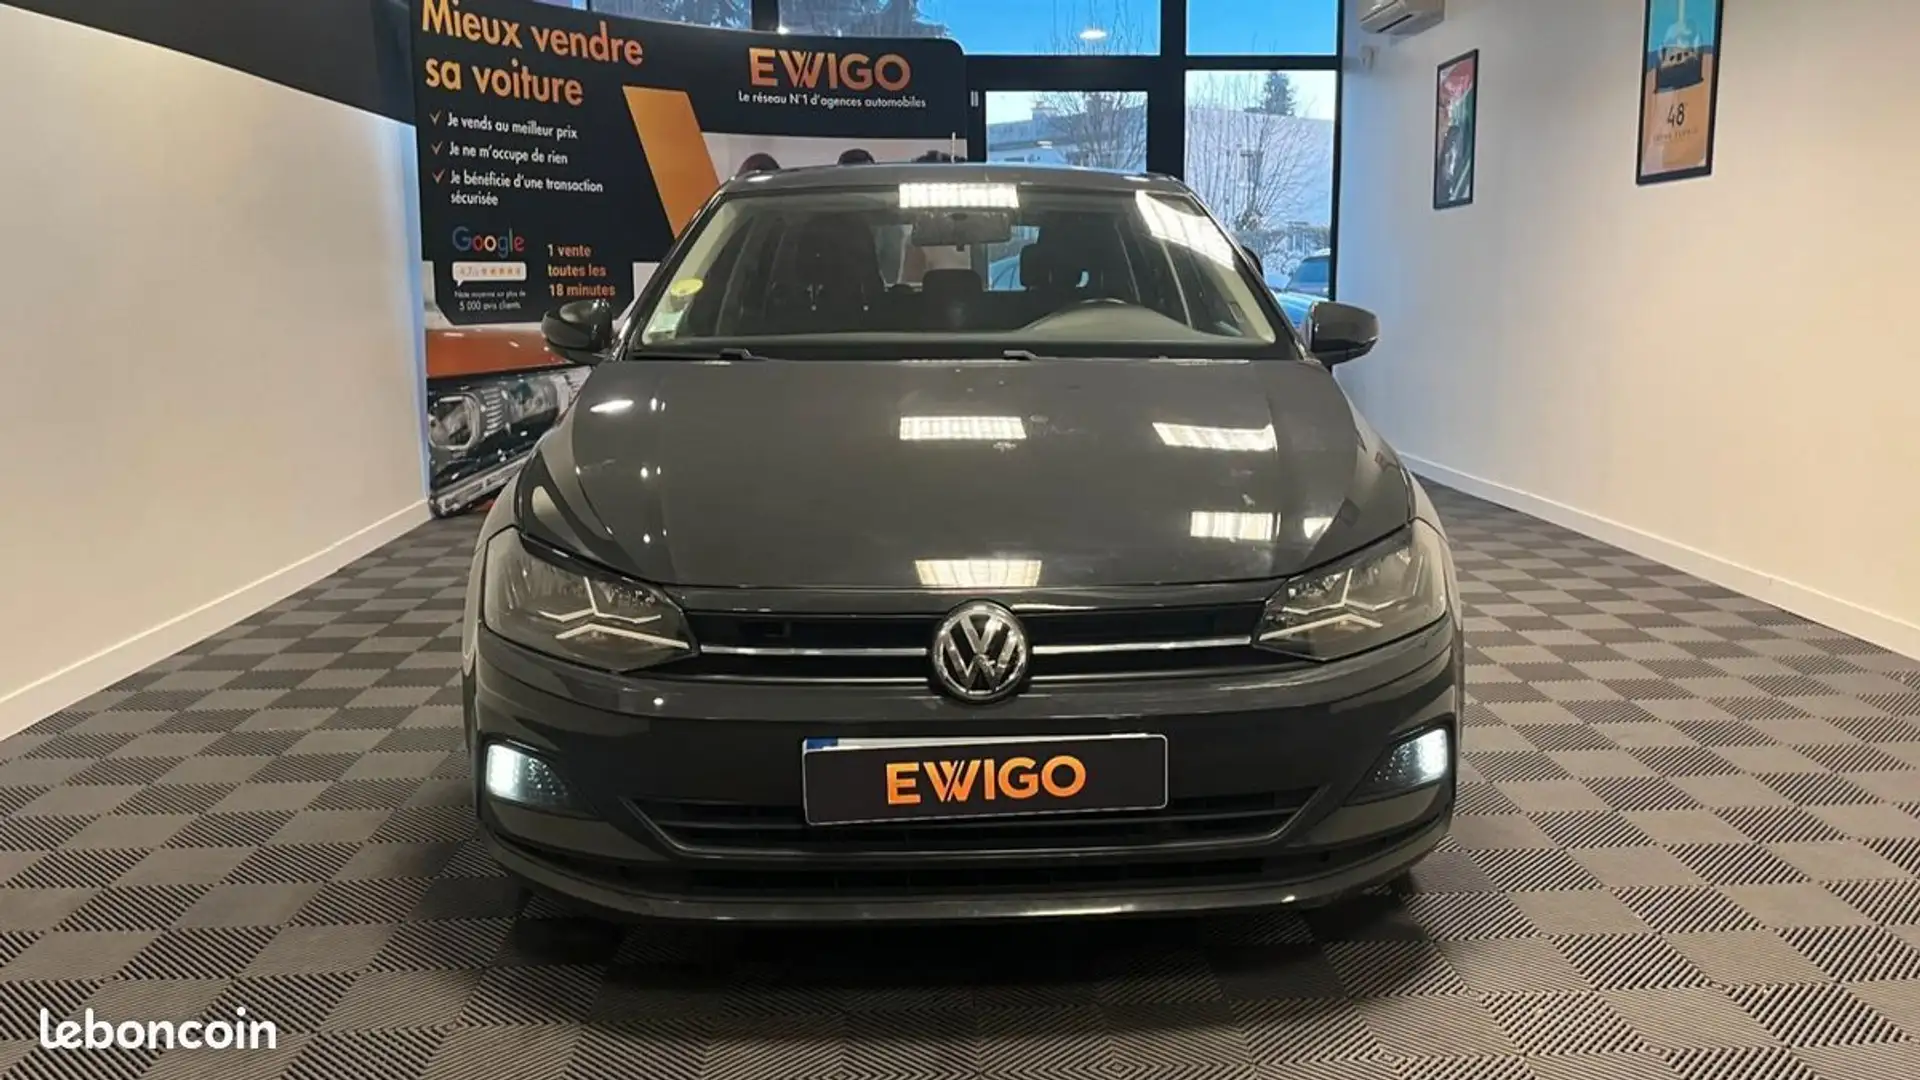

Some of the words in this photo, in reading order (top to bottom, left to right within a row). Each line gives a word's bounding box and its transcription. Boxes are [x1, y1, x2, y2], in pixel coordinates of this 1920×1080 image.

[422, 0, 523, 49] Mieux
[531, 20, 643, 66] vendre
[425, 57, 461, 90] sa
[472, 58, 584, 105] voiture
[749, 47, 911, 92] EWIGO
[738, 91, 750, 102] Le
[752, 92, 787, 105] réseau
[810, 94, 862, 109] d'agences
[864, 96, 926, 108] automobiles
[447, 112, 459, 127] Je
[461, 115, 492, 131] vends
[495, 119, 508, 132] au
[512, 120, 553, 137] meilleur
[556, 124, 577, 141] prix
[1667, 103, 1685, 128] 48
[449, 141, 460, 155] Je
[462, 147, 476, 157] ne
[479, 146, 528, 164] m'occupe
[531, 148, 544, 163] de
[548, 151, 568, 164] rien
[450, 170, 460, 184] Je
[463, 170, 510, 188] bénéficie
[513, 172, 543, 189] d'une
[546, 178, 603, 192] transaction
[450, 191, 498, 205] sécurisée
[452, 226, 525, 258] Google
[547, 244, 553, 257] 1
[558, 245, 591, 257] vente
[548, 264, 585, 277] toutes
[588, 264, 606, 277] les
[550, 284, 563, 297] 18
[566, 283, 615, 296] minutes
[459, 302, 465, 311] 5
[467, 301, 481, 311] 000
[483, 302, 497, 310] avis
[499, 301, 521, 310] clients
[886, 755, 1086, 805] EWIGO
